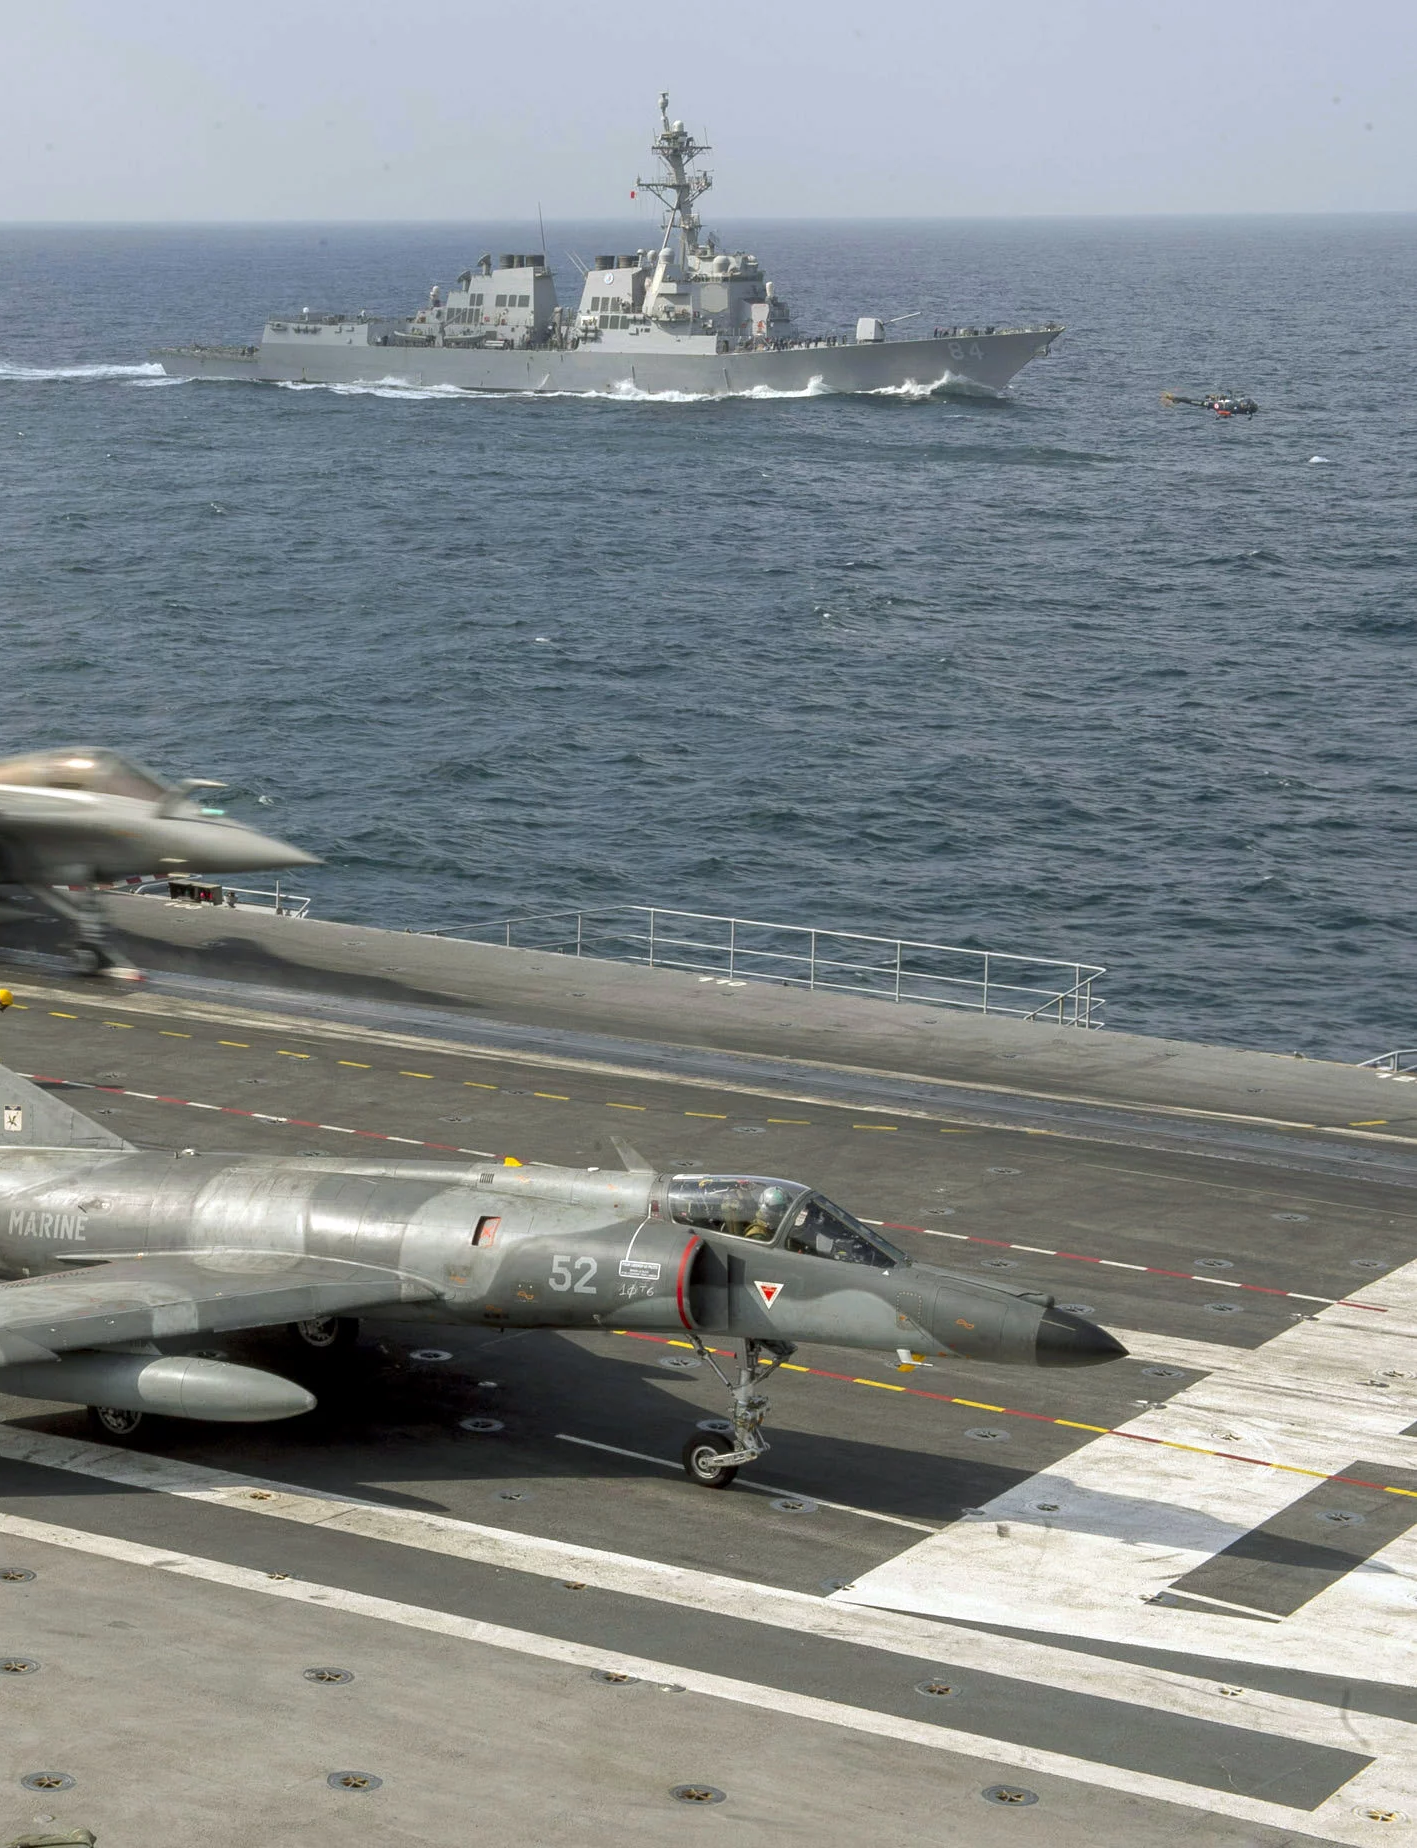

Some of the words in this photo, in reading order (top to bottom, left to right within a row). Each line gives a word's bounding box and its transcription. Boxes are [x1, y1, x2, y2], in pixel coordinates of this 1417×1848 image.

[948, 341, 984, 360] 84
[7, 1209, 89, 1241] MARINE
[548, 1254, 598, 1295] 52
